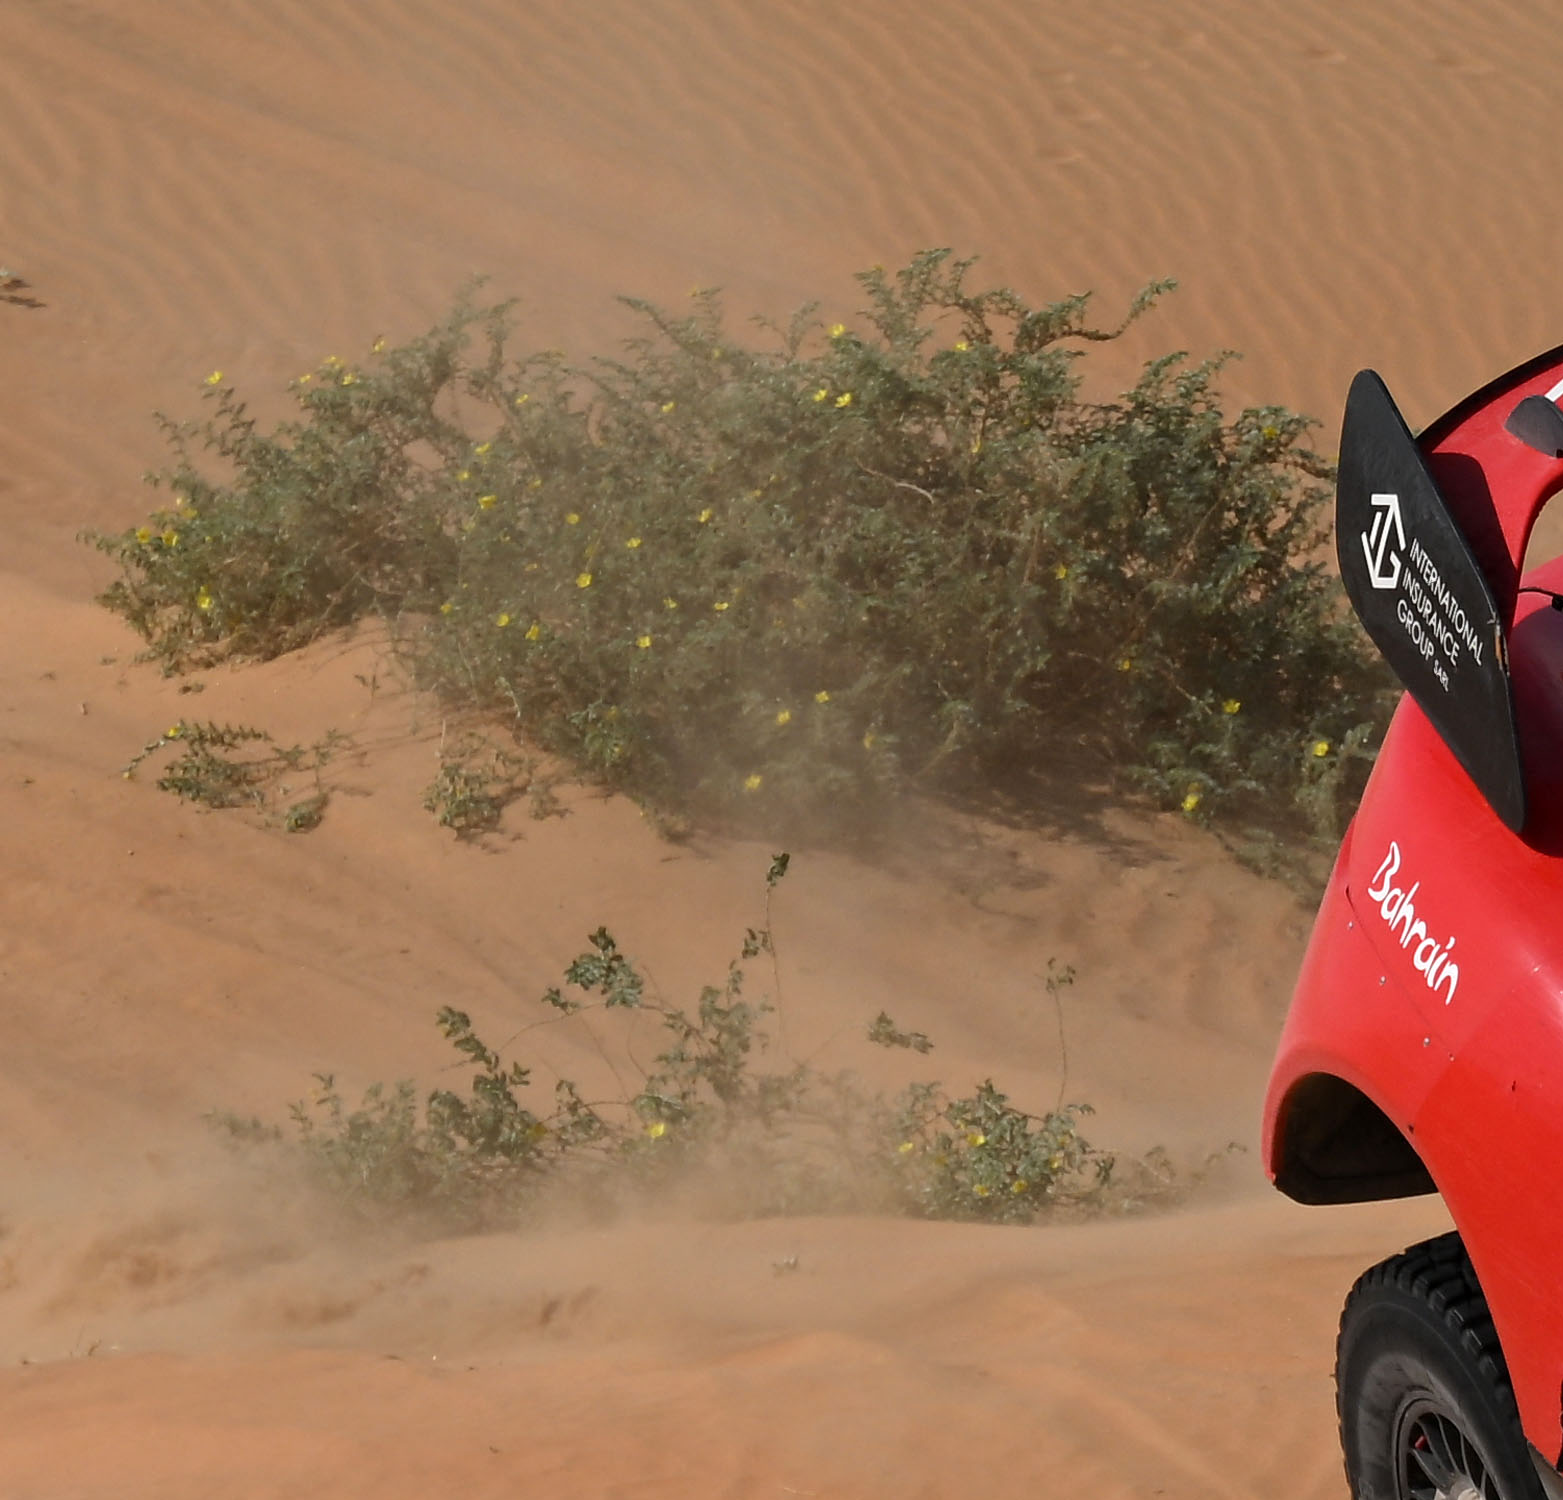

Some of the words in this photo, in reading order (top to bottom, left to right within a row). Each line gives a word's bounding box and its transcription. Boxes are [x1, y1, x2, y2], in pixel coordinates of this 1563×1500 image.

[1397, 600, 1435, 661] GROUP
[1433, 659, 1449, 692] SARL
[1402, 567, 1460, 667] INSURANCE
[1409, 538, 1483, 666] INTERNATIONAL
[1368, 841, 1459, 1005] Bahrain
